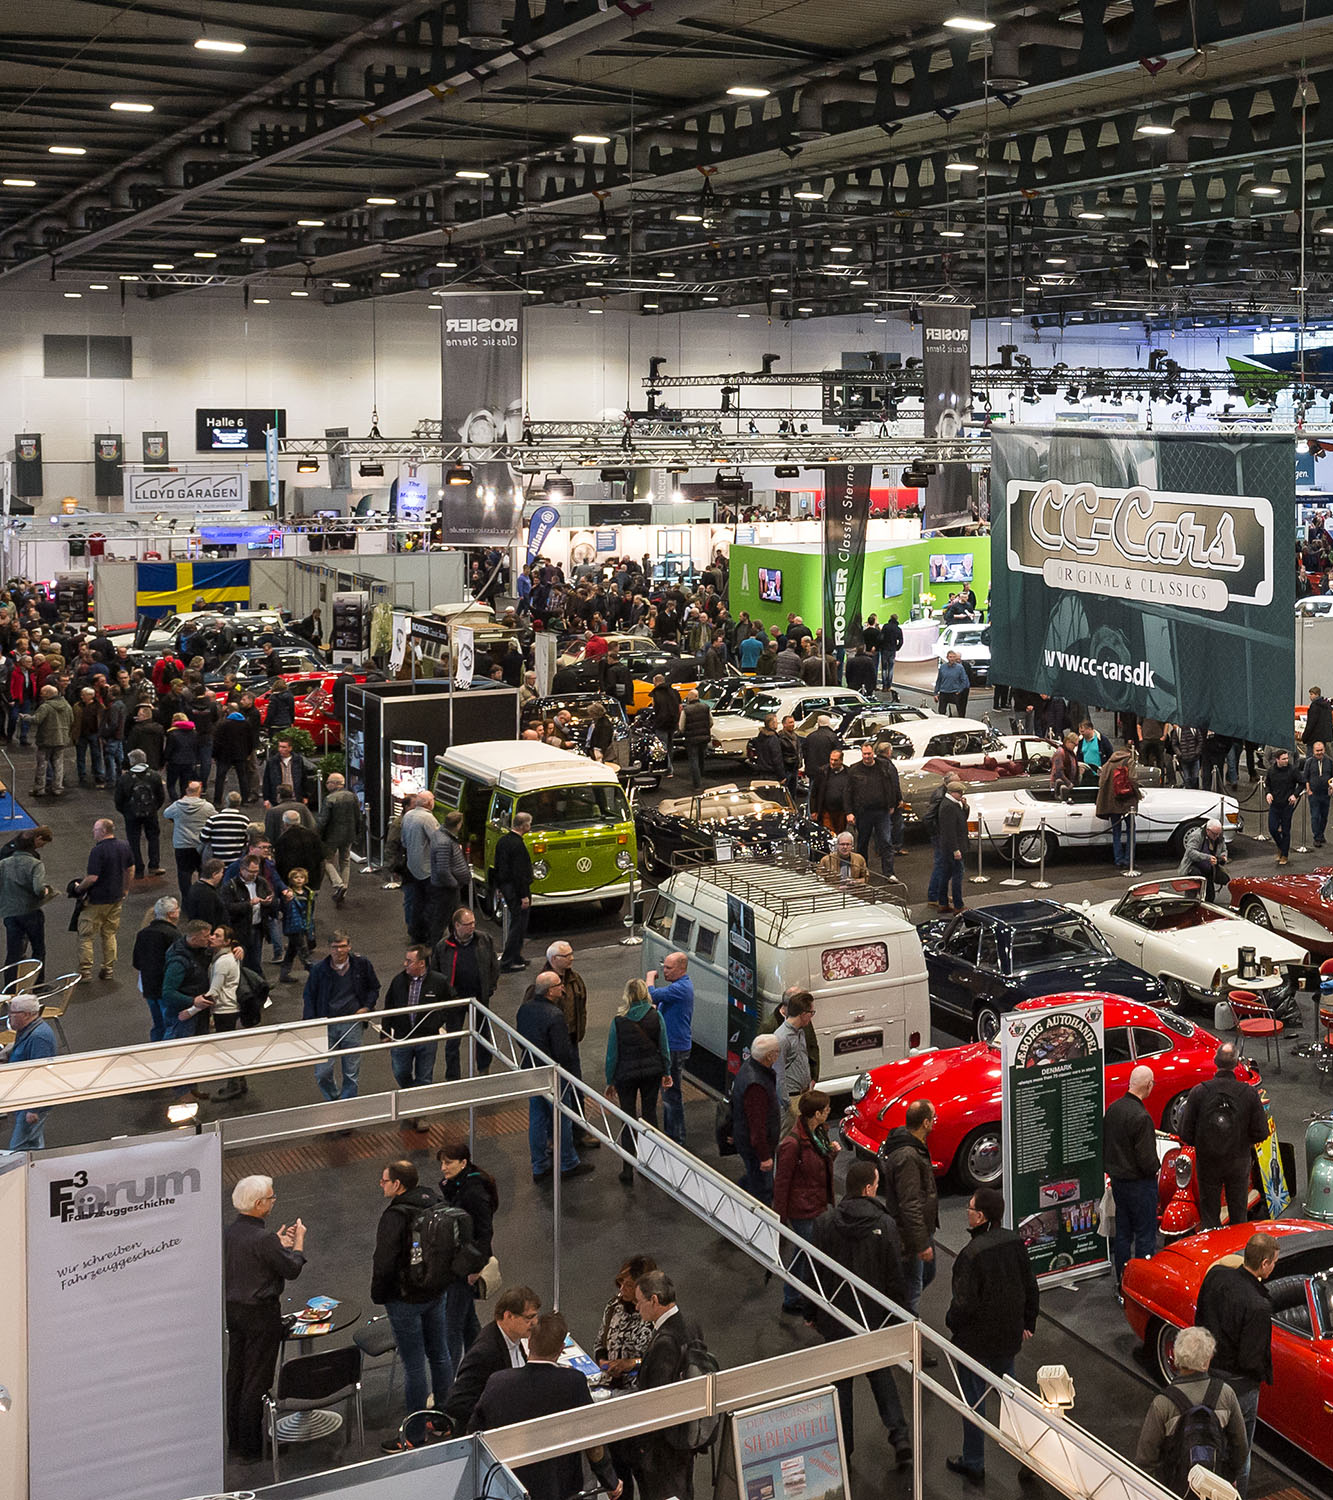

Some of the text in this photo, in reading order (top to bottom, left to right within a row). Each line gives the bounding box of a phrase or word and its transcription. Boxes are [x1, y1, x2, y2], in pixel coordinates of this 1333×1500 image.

[206, 417, 244, 427] Halle 6
[135, 488, 238, 500] LLOYD GARAGEN
[529, 523, 547, 556] Allianz
[838, 513, 853, 563] Classic
[1030, 480, 1245, 572] CC-Cars
[1057, 565, 1207, 600] ORIGINAL & CLASSICS
[833, 568, 848, 646] ROSIER
[839, 1037, 878, 1049] CC-Cars
[1016, 1015, 1097, 1069] LÆBORG AUTOHANDEL
[1041, 1064, 1072, 1075] DENMARK
[68, 1198, 176, 1222] Fahrzeuggeschichte
[57, 1240, 142, 1278] Wir schreiben
[60, 1237, 182, 1291] Fahrzeuggeschichte
[743, 1415, 831, 1457] SILBERPFEIL
[746, 1417, 765, 1430] DER
